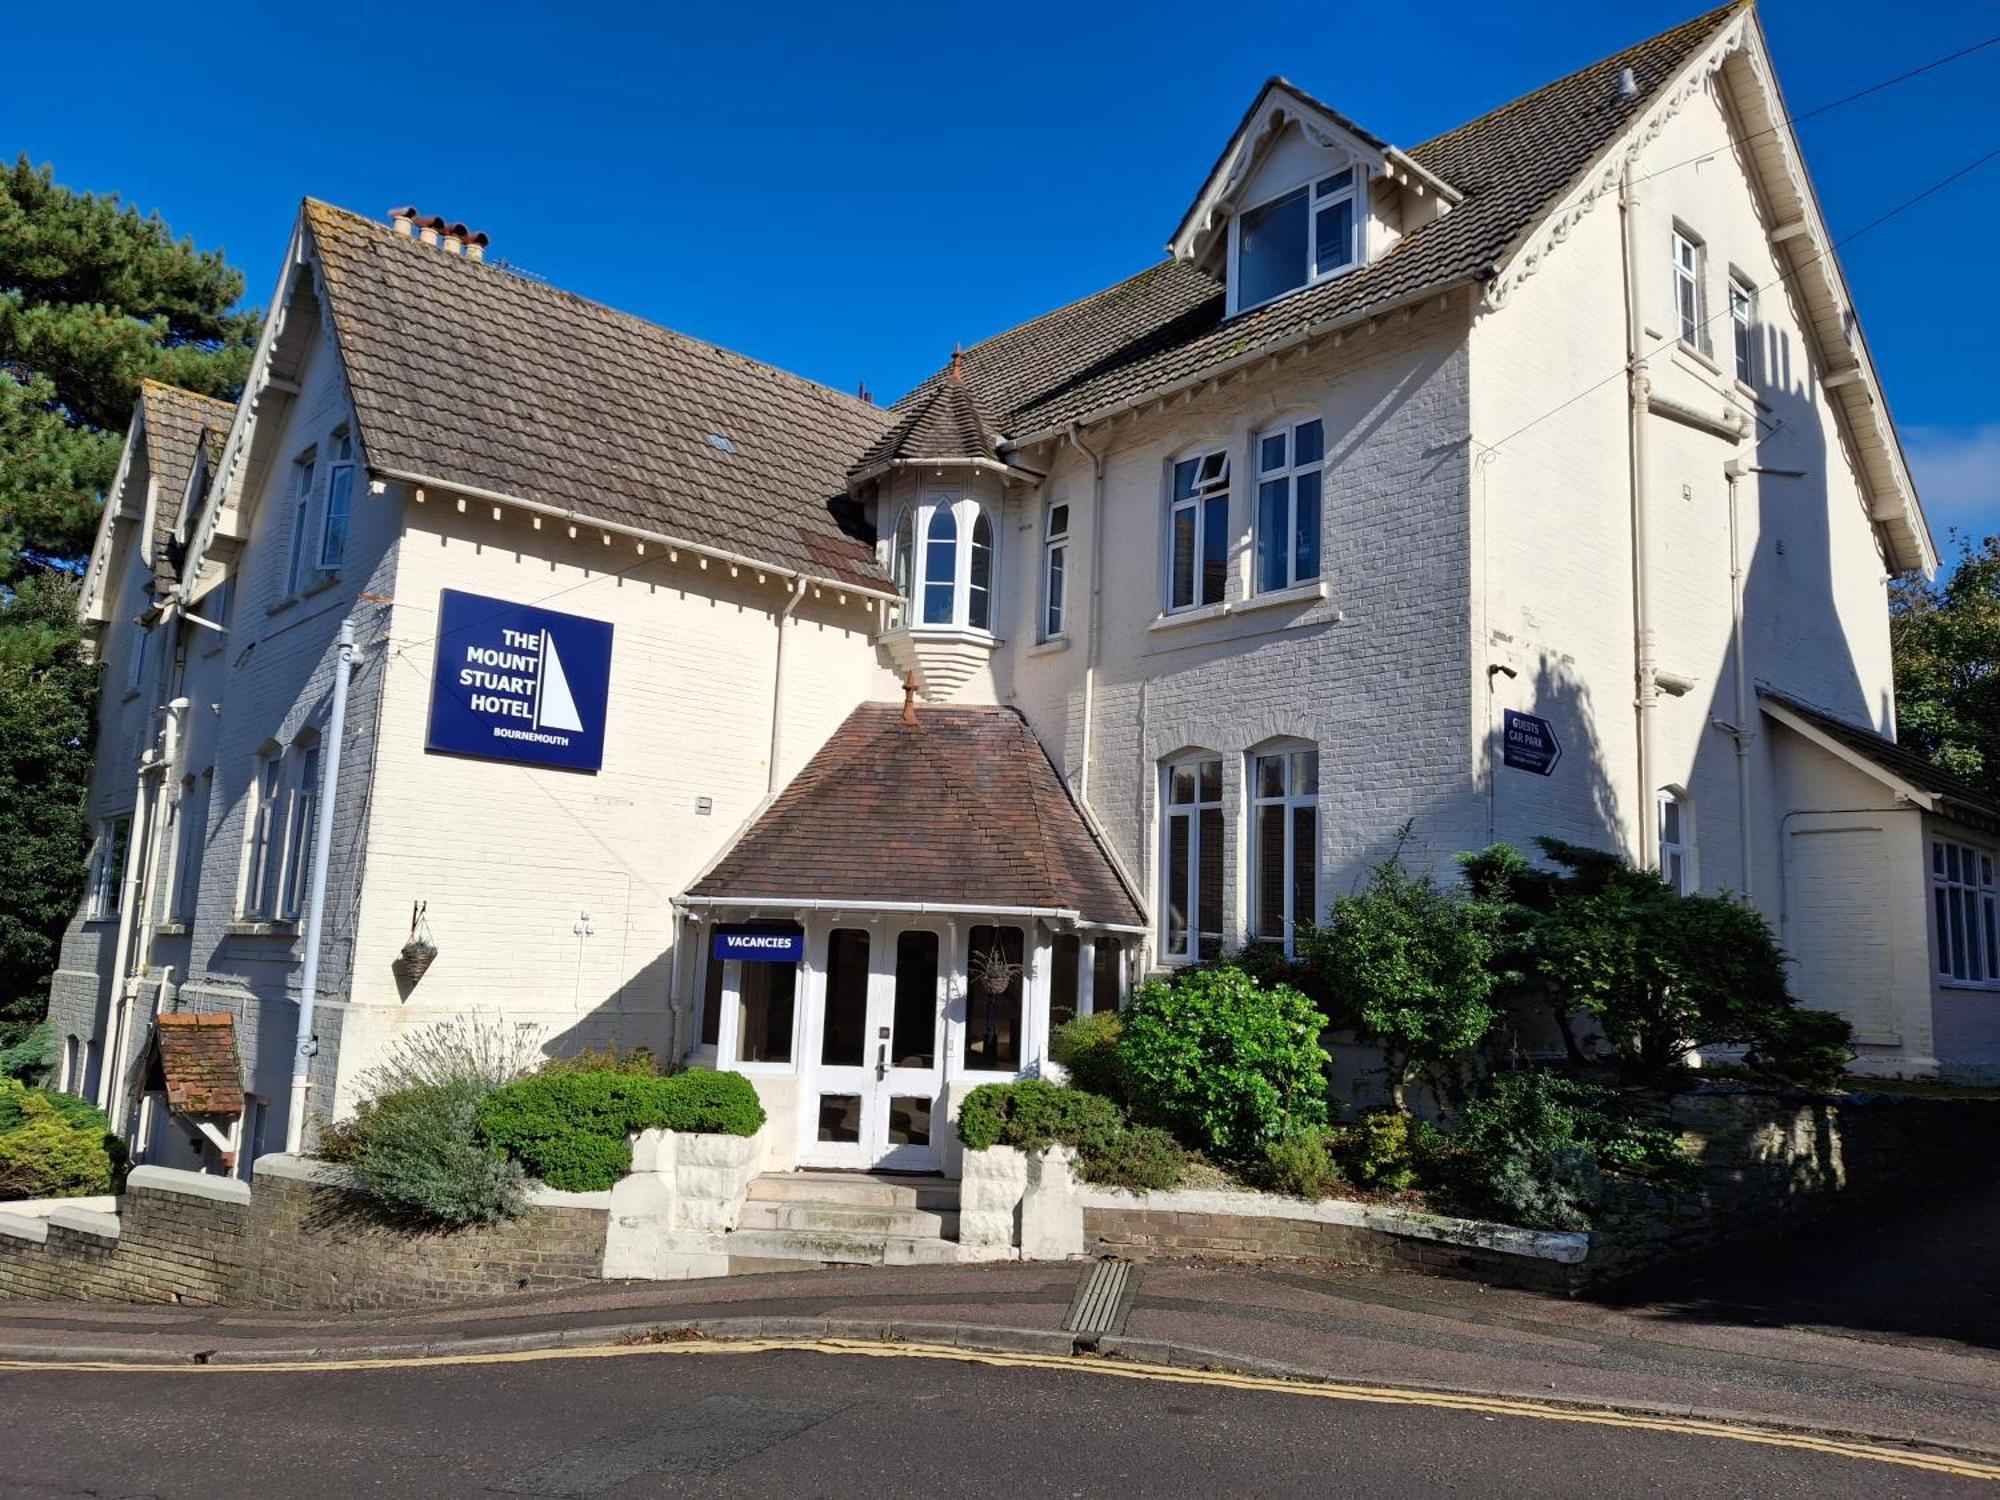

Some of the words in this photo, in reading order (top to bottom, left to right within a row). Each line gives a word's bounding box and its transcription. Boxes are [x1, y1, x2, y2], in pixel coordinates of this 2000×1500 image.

[502, 629, 539, 651] THE
[467, 646, 538, 673] MOUNT
[460, 669, 536, 695] STUART
[470, 694, 533, 719] HOTEL
[1512, 718, 1540, 734] GUESTS
[493, 727, 569, 746] BOURNEMOUTH
[1508, 730, 1524, 743] CAR
[1524, 734, 1544, 748] PARK
[727, 936, 792, 949] VACANCIES
